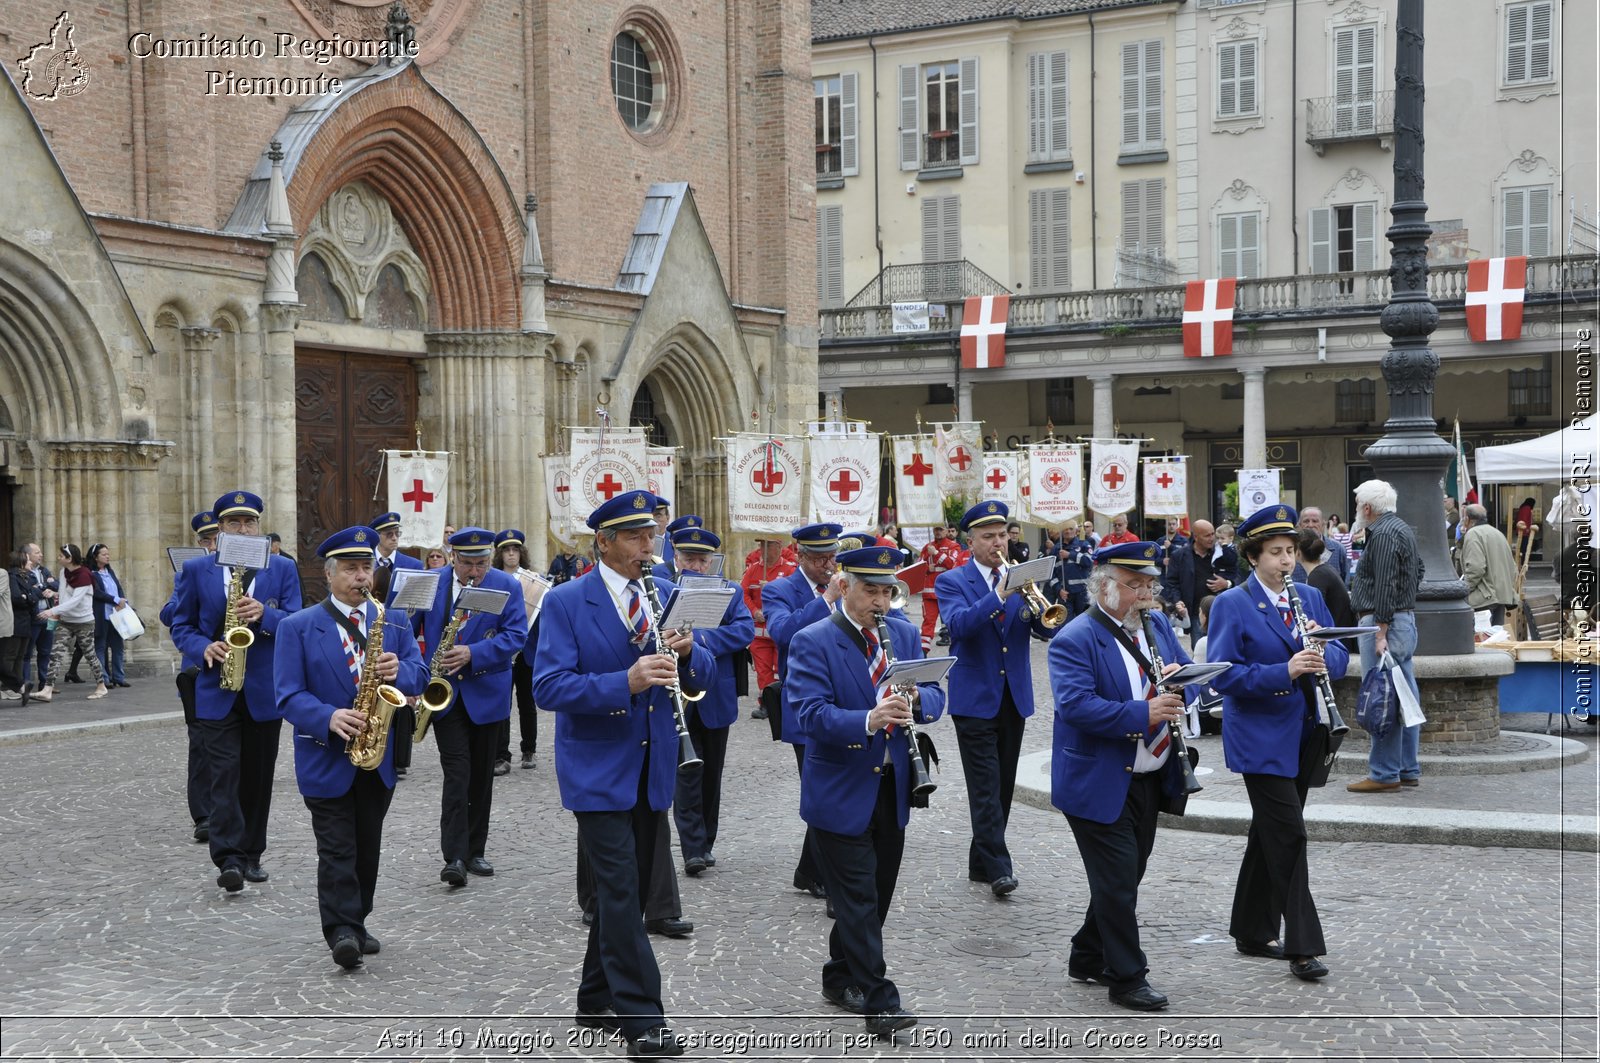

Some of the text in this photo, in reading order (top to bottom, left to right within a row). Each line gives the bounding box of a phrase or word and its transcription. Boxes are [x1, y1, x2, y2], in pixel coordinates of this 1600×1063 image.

[736, 452, 753, 474] CROCE
[817, 456, 872, 480] CROCE ROSSA ITALIANA
[744, 503, 782, 511] DELEGAZIONE
[734, 513, 799, 523] MONTEGROSSO D'ASTI
